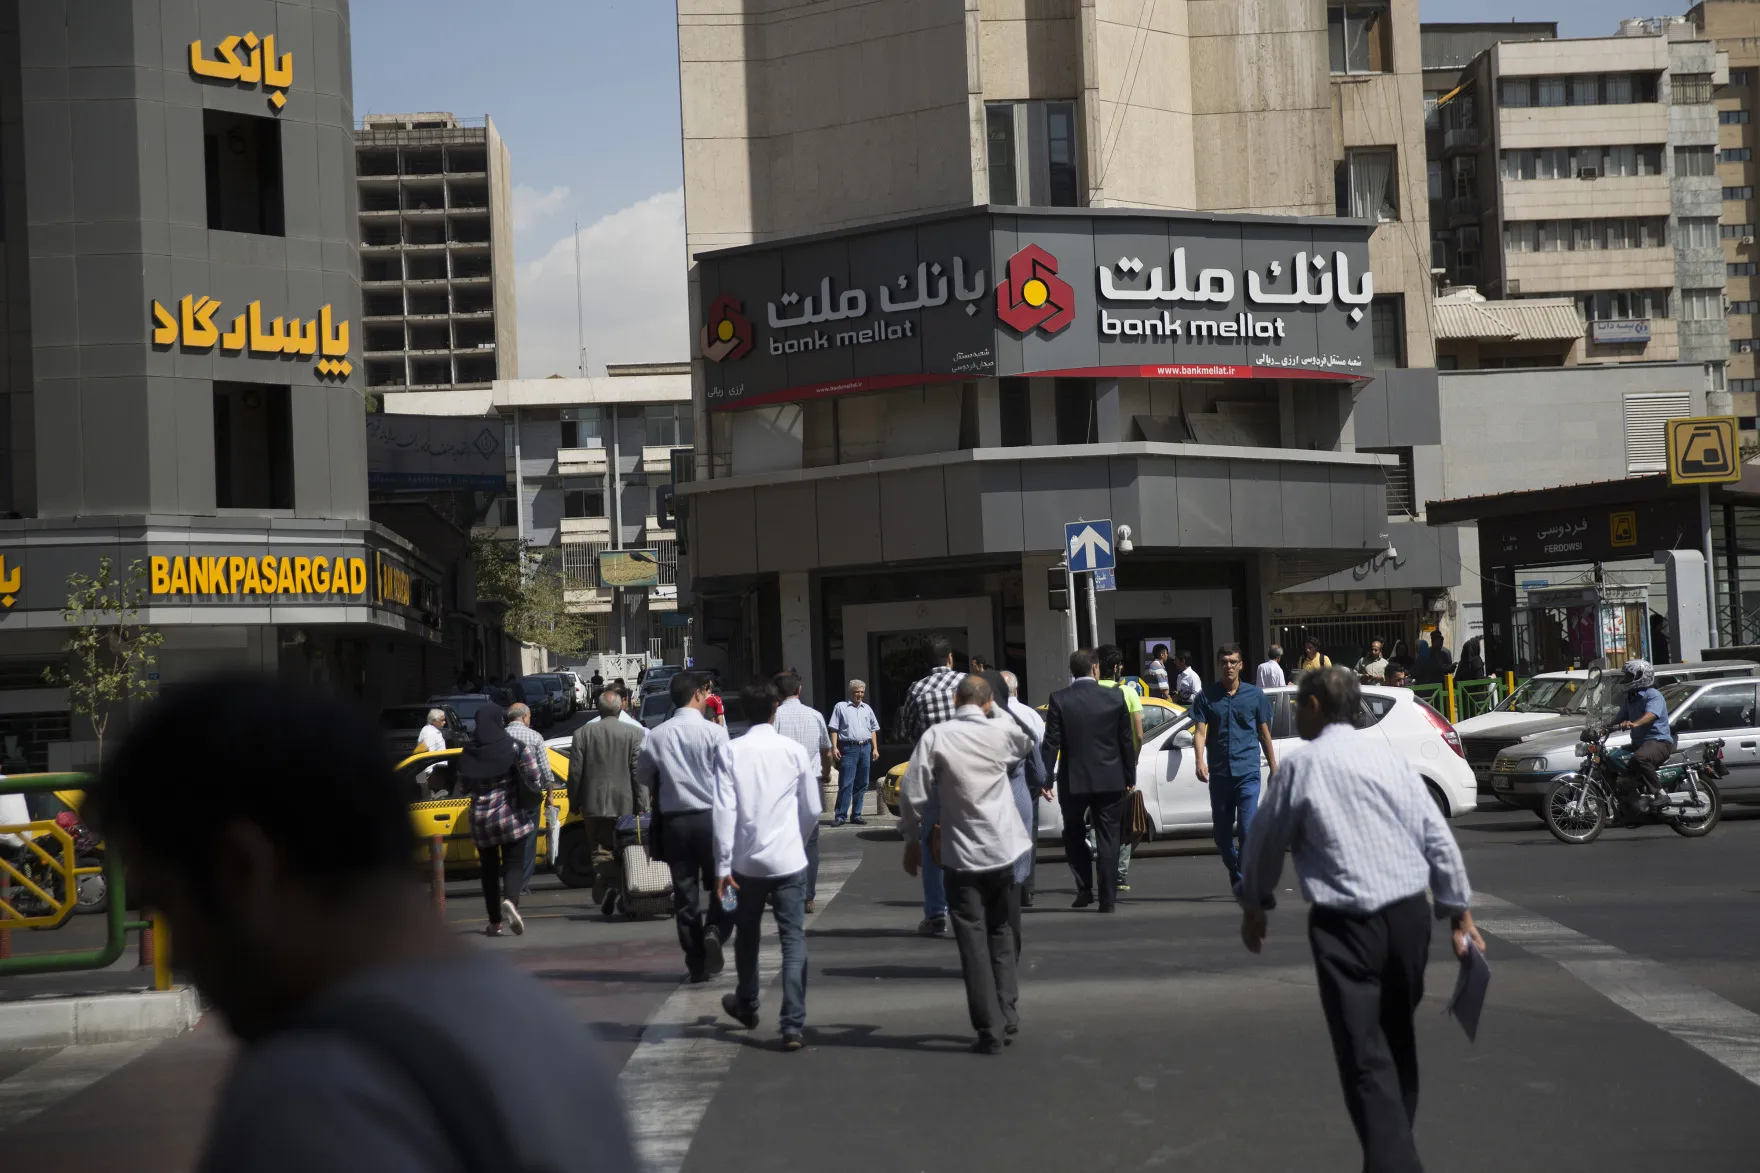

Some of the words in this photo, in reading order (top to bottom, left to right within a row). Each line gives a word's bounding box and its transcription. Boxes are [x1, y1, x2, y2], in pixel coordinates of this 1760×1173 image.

[190, 31, 293, 109] بانک
[1099, 247, 1235, 303] ملت
[767, 276, 867, 329] ملت
[152, 294, 353, 377] پاسارگاد
[769, 329, 829, 356] bank
[836, 319, 913, 347] mellat
[1101, 310, 1182, 336] bank
[1190, 312, 1286, 338] mellat
[1157, 365, 1236, 375] www.bankmellat.ir
[1537, 517, 1589, 540] فردوسی
[1544, 542, 1583, 553] FERDOWSI
